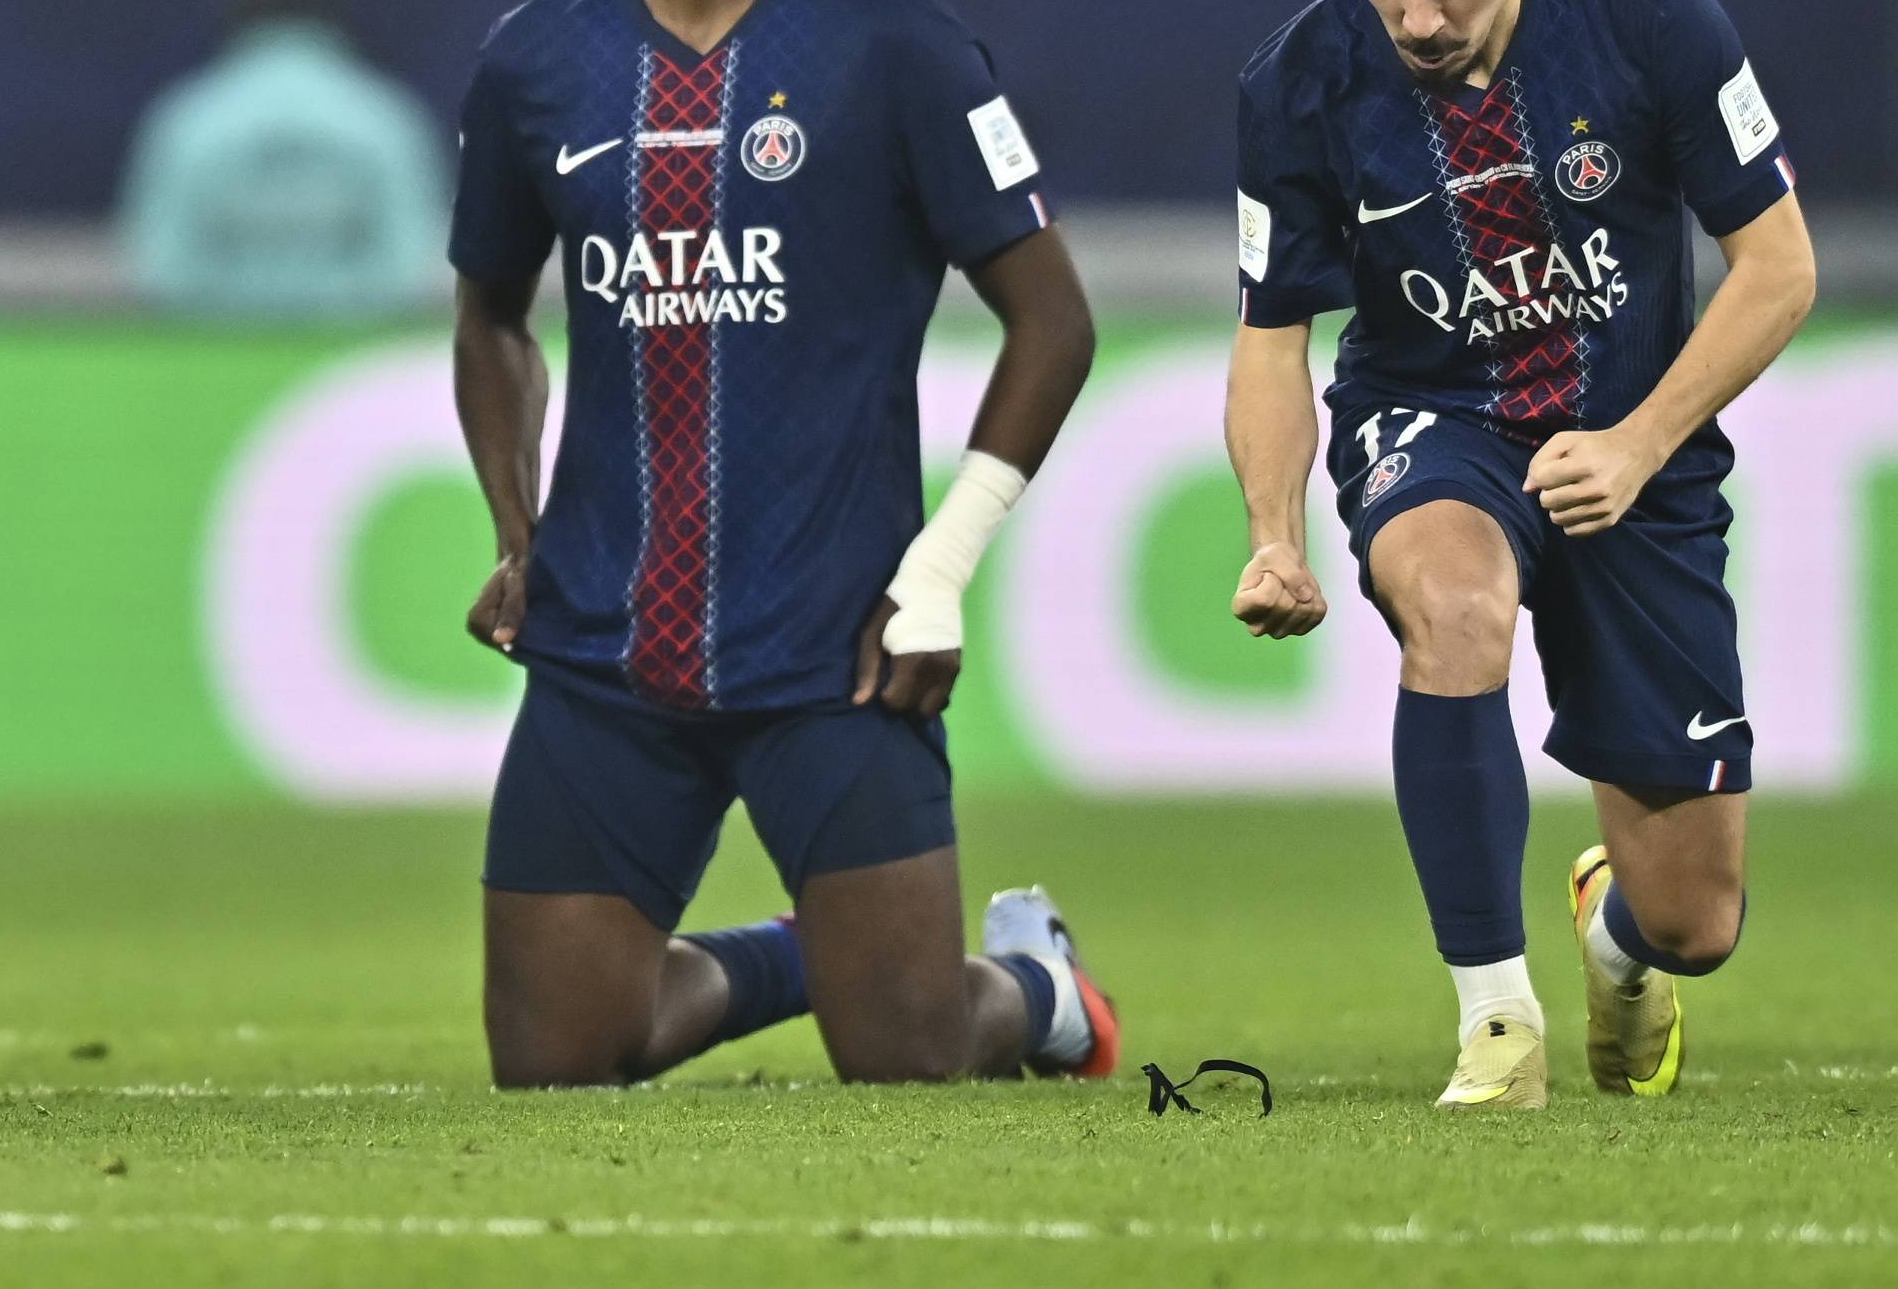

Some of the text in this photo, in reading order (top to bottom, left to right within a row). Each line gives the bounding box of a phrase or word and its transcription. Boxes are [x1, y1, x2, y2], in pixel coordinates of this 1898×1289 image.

[752, 120, 794, 137] PARIS
[1562, 143, 1605, 165] PARIS
[581, 227, 786, 304] QATAR
[1399, 227, 1620, 333] QATAR
[617, 286, 788, 329] AIRWAYS
[1466, 270, 1629, 346] AIRWAYS
[1355, 407, 1438, 468] 17
